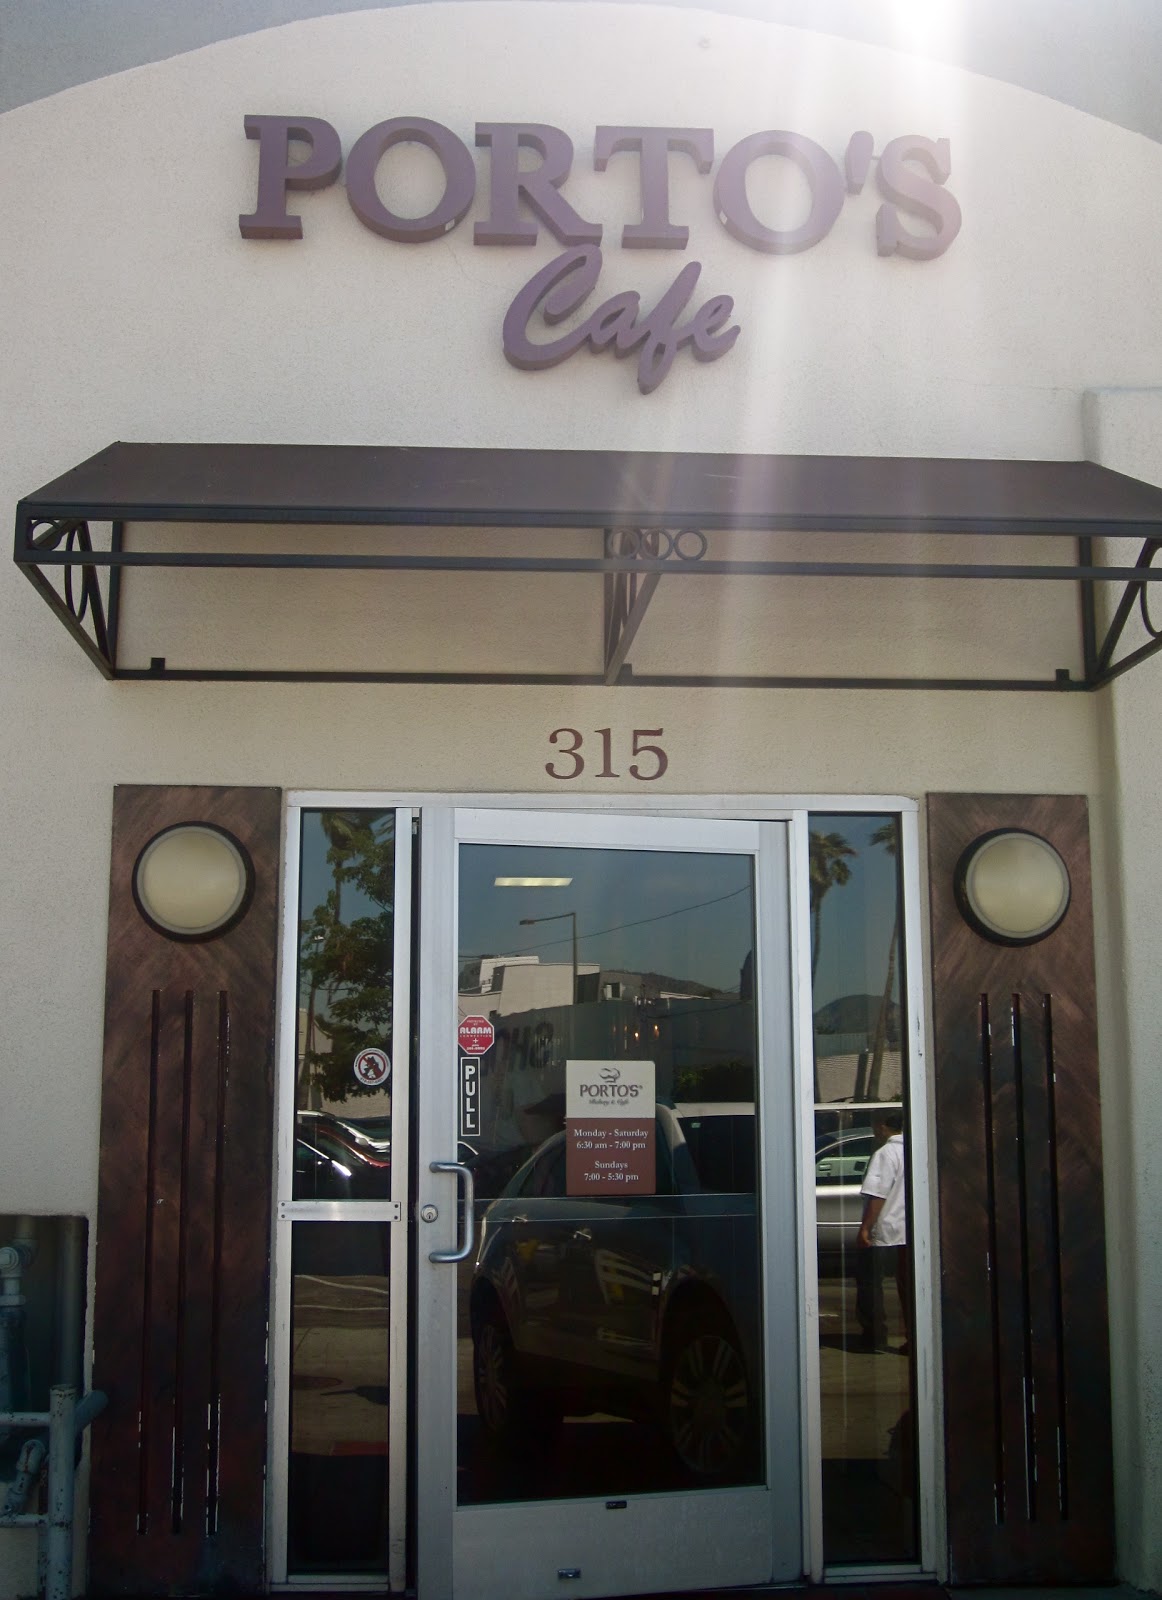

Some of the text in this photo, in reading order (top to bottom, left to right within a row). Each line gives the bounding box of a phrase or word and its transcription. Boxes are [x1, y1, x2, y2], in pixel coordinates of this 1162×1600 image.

[239, 114, 962, 261] PORTO'S
[502, 243, 741, 395] Cafe
[545, 728, 668, 780] 315
[465, 1065, 476, 1128] PULL
[579, 1084, 639, 1097] PORTO'S
[574, 1129, 607, 1139] Monday
[614, 1129, 649, 1139] Saturday
[576, 1141, 593, 1149] 6:30
[615, 1141, 631, 1149] 7:00
[632, 1143, 646, 1151] pm
[594, 1161, 629, 1170] Sundays
[584, 1173, 600, 1181] 7:00
[607, 1173, 624, 1181] 5:30
[625, 1175, 639, 1183] pm
